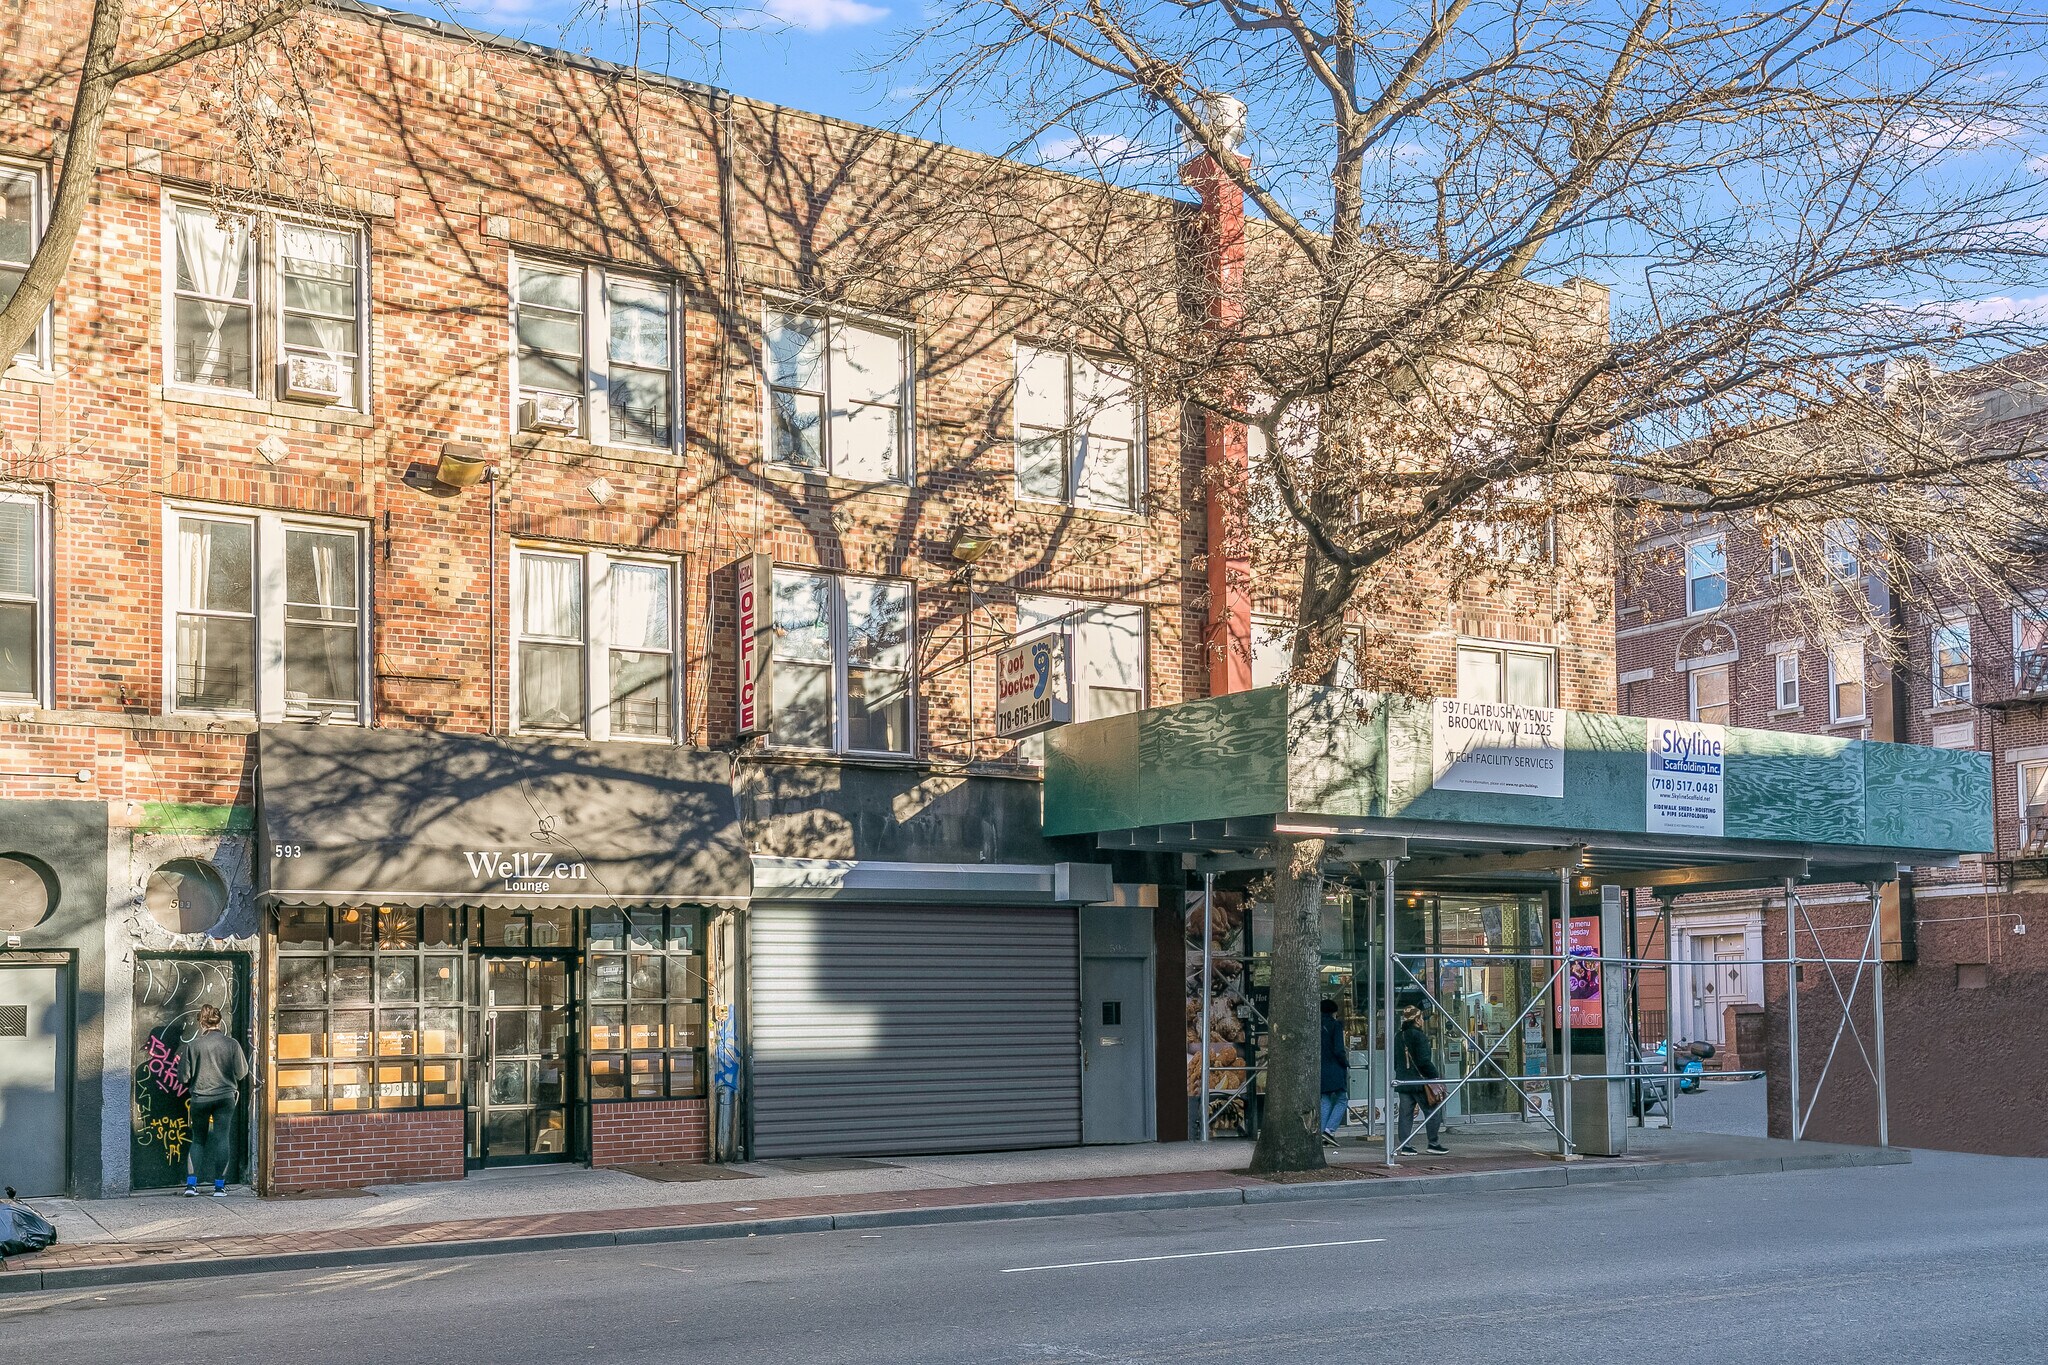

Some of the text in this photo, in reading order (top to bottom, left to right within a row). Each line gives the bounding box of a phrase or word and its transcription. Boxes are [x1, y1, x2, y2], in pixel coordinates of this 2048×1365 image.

[741, 591, 754, 730] OFFICE
[1000, 650, 1025, 677] Foot
[1000, 672, 1036, 700] Doctor
[999, 697, 1051, 732] 718-675-1100
[1442, 701, 1554, 723] 597 FLATBUSH AVENUE
[1448, 715, 1552, 737] BROOKLYN, NY 11225
[1663, 729, 1721, 760] Skyline
[1445, 751, 1554, 769] XTECH FACILITY SERVICES
[1664, 760, 1720, 774] Scaffolding Inc.
[1652, 777, 1718, 794] (718) 517.0481
[1653, 803, 1677, 811] SIDEWALK
[1695, 806, 1716, 814] HOISTING
[1678, 811, 1709, 819] SCAFFOLDING
[275, 844, 302, 859] 593
[463, 851, 587, 880] WellZen
[504, 879, 550, 893] Lounge
[170, 899, 192, 909] 593
